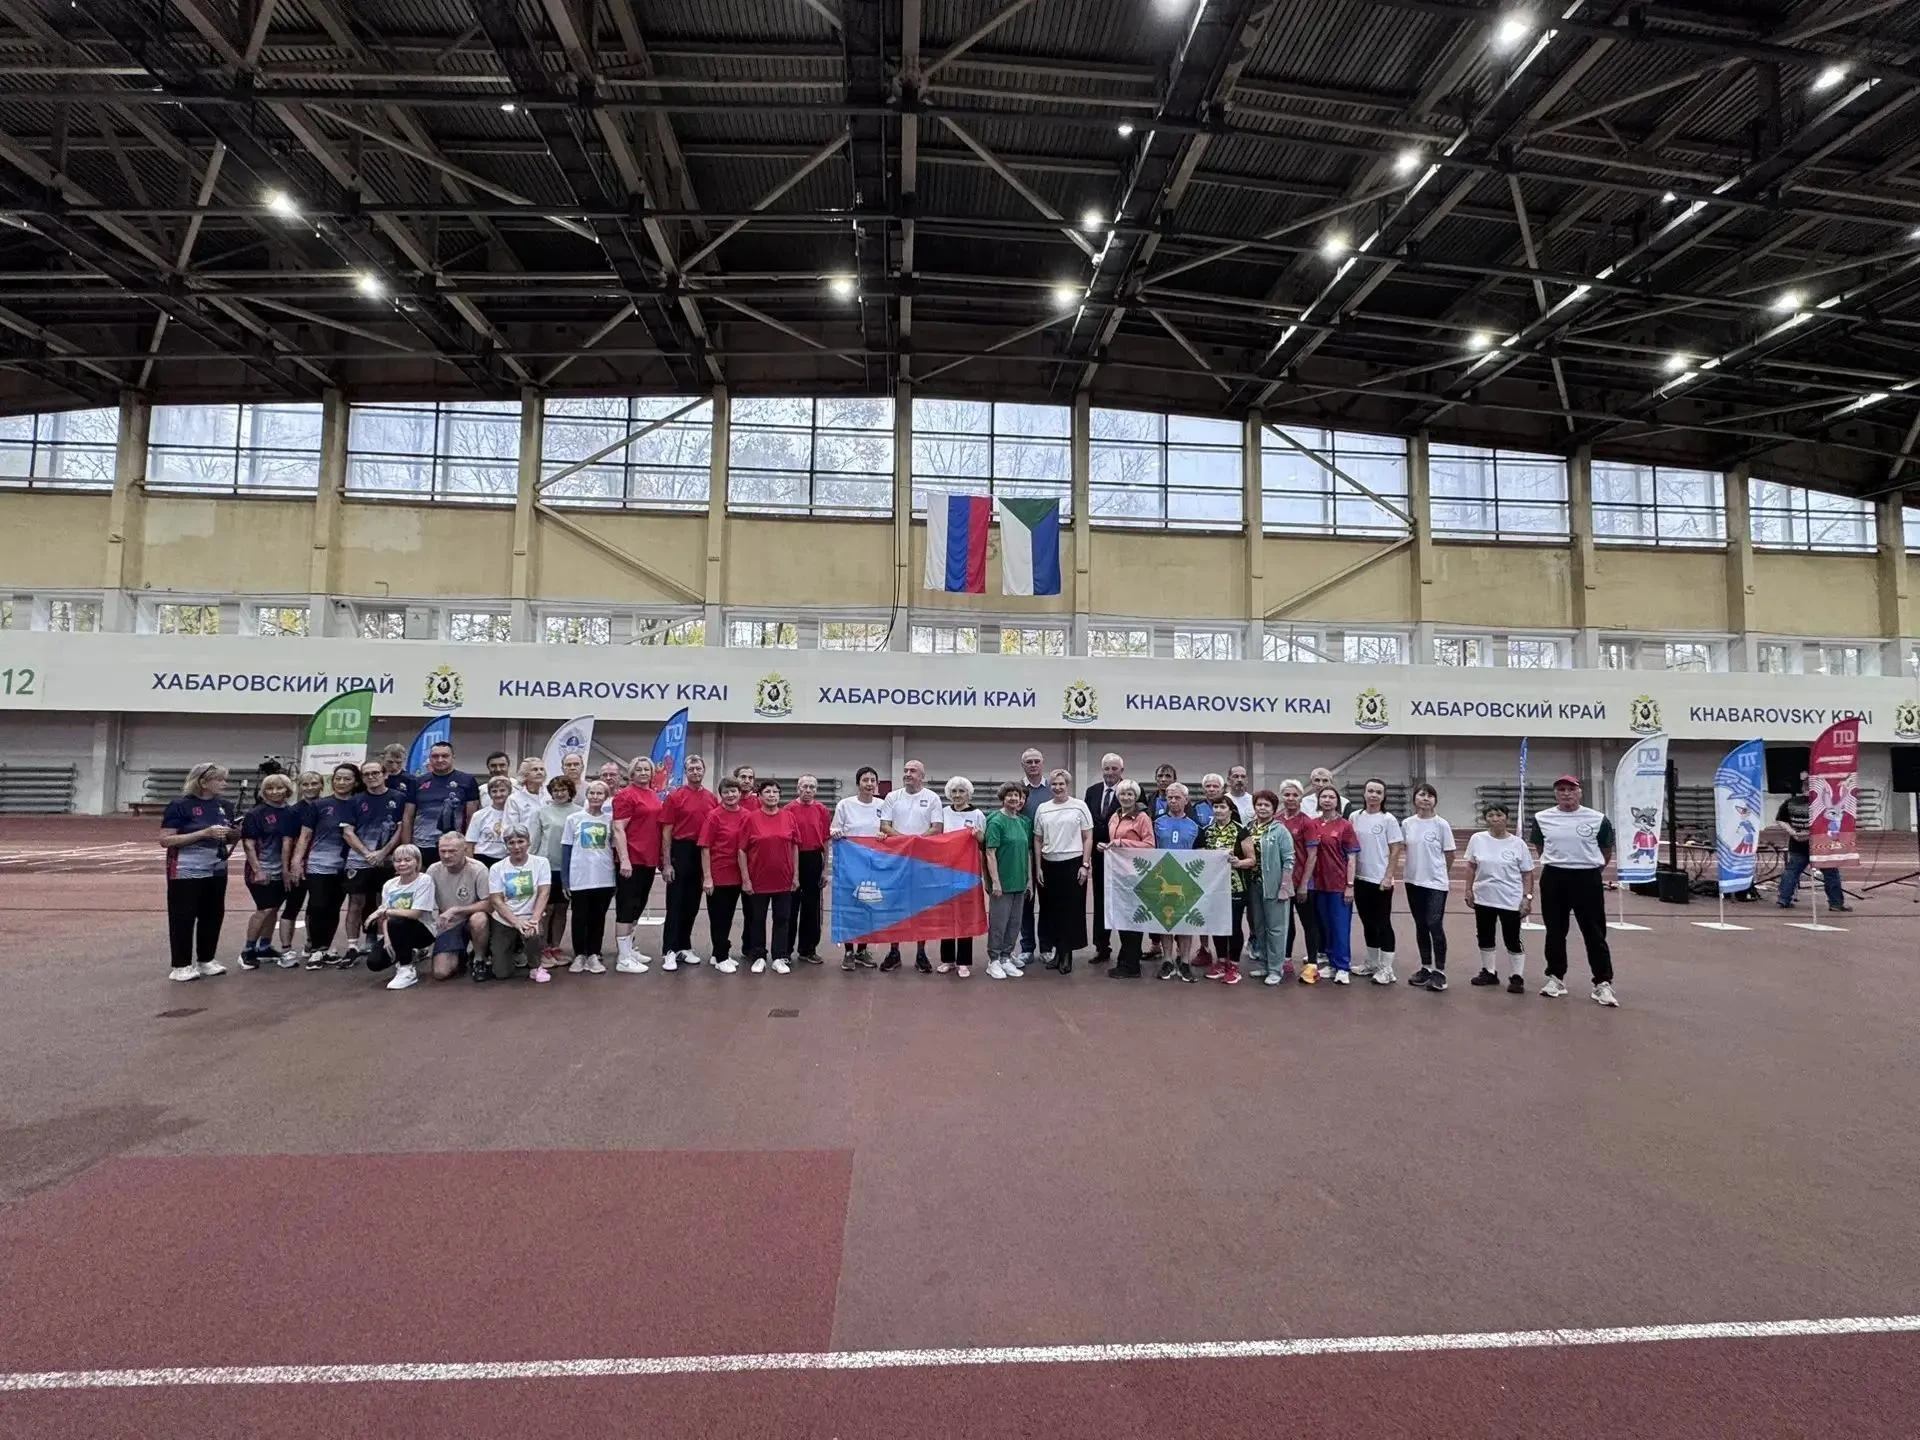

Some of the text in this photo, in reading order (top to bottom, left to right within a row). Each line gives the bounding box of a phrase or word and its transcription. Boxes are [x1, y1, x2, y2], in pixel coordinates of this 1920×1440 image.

[2, 668, 35, 695] 12
[152, 671, 394, 694] ХАБАРОВСКИЙ КРАЙ
[499, 680, 728, 702] KHABAROVSKY KRAI
[818, 685, 1036, 708] ХАБАРОВСКИЙ КРАЙ
[1126, 694, 1331, 714] KHABAROVSKY KRAI
[1410, 700, 1605, 719] ХАБАРОВСКИЙ КРАЙ
[1690, 705, 1826, 724] KHABAROVSKY
[1172, 831, 1179, 843] 8
